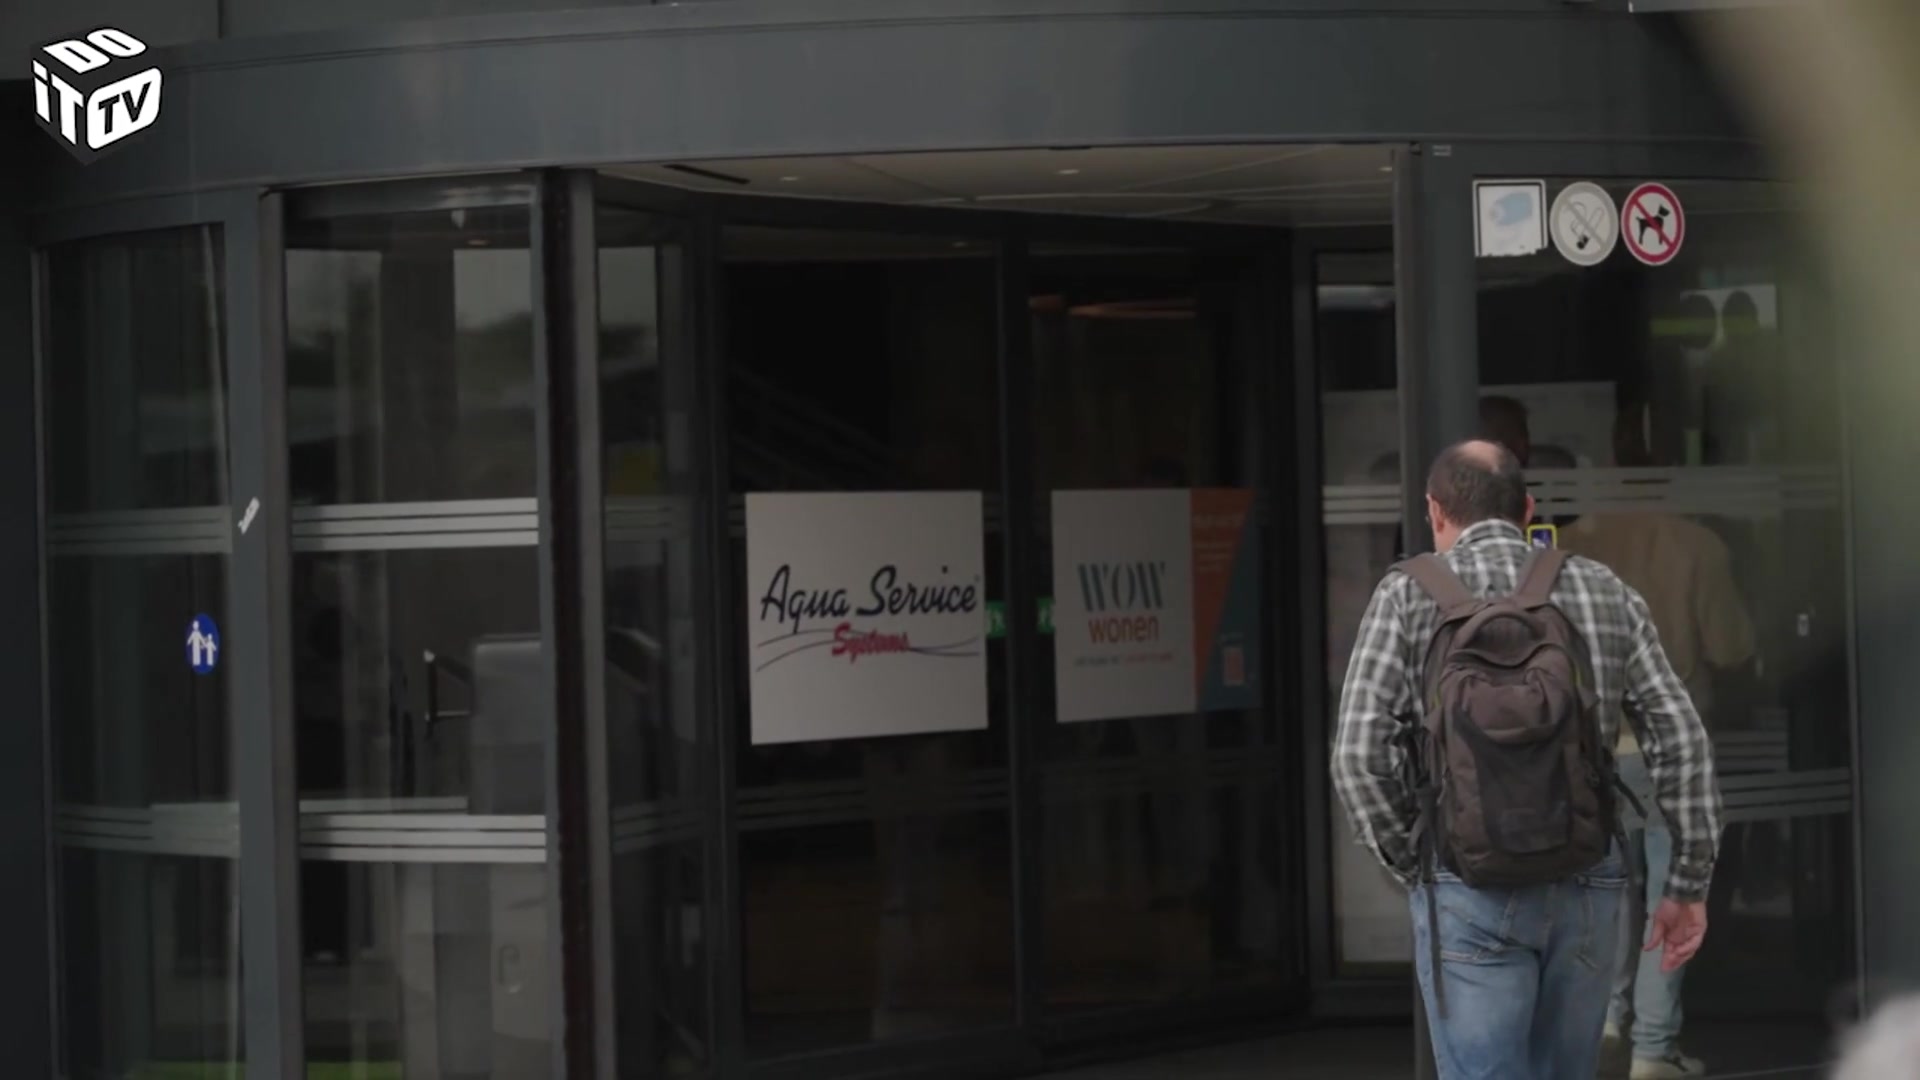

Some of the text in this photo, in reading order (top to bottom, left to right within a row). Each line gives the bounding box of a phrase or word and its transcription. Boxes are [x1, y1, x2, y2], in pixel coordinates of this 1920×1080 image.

[761, 564, 978, 634] Aqua Service
[1077, 561, 1166, 612] WOW
[832, 622, 910, 664] Systems
[1088, 615, 1159, 643] wonen
